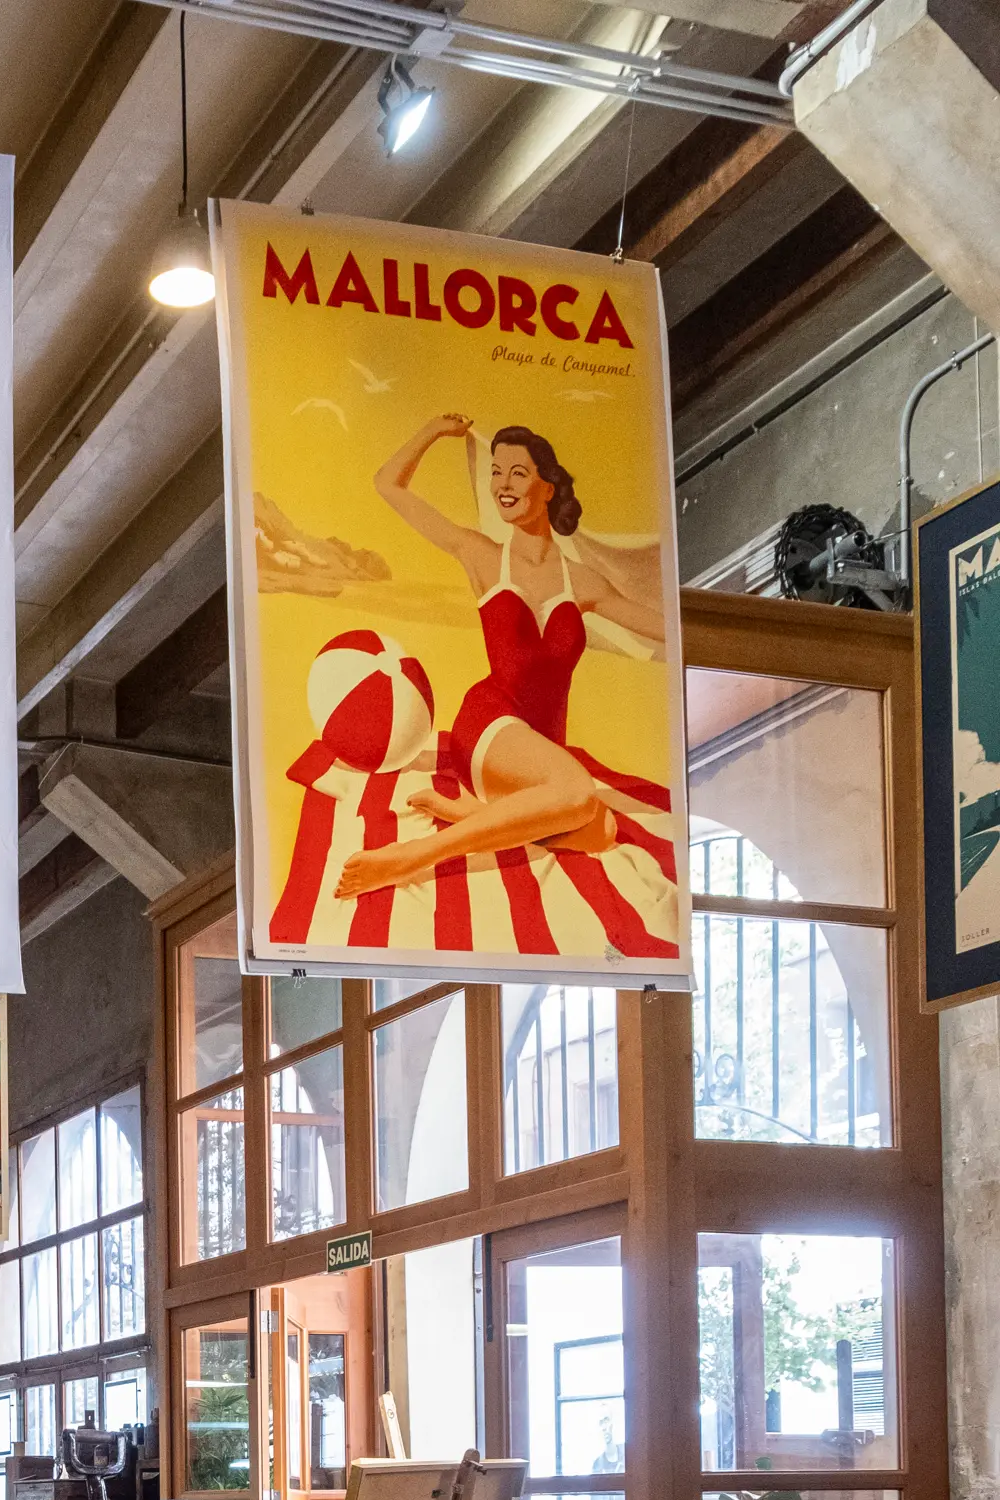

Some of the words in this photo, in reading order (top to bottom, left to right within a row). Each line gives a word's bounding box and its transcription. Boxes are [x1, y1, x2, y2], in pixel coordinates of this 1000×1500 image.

[262, 240, 635, 350] MALLORCA
[491, 345, 535, 367] Playa
[540, 351, 557, 366] de
[329, 1240, 370, 1267] SALIDA
